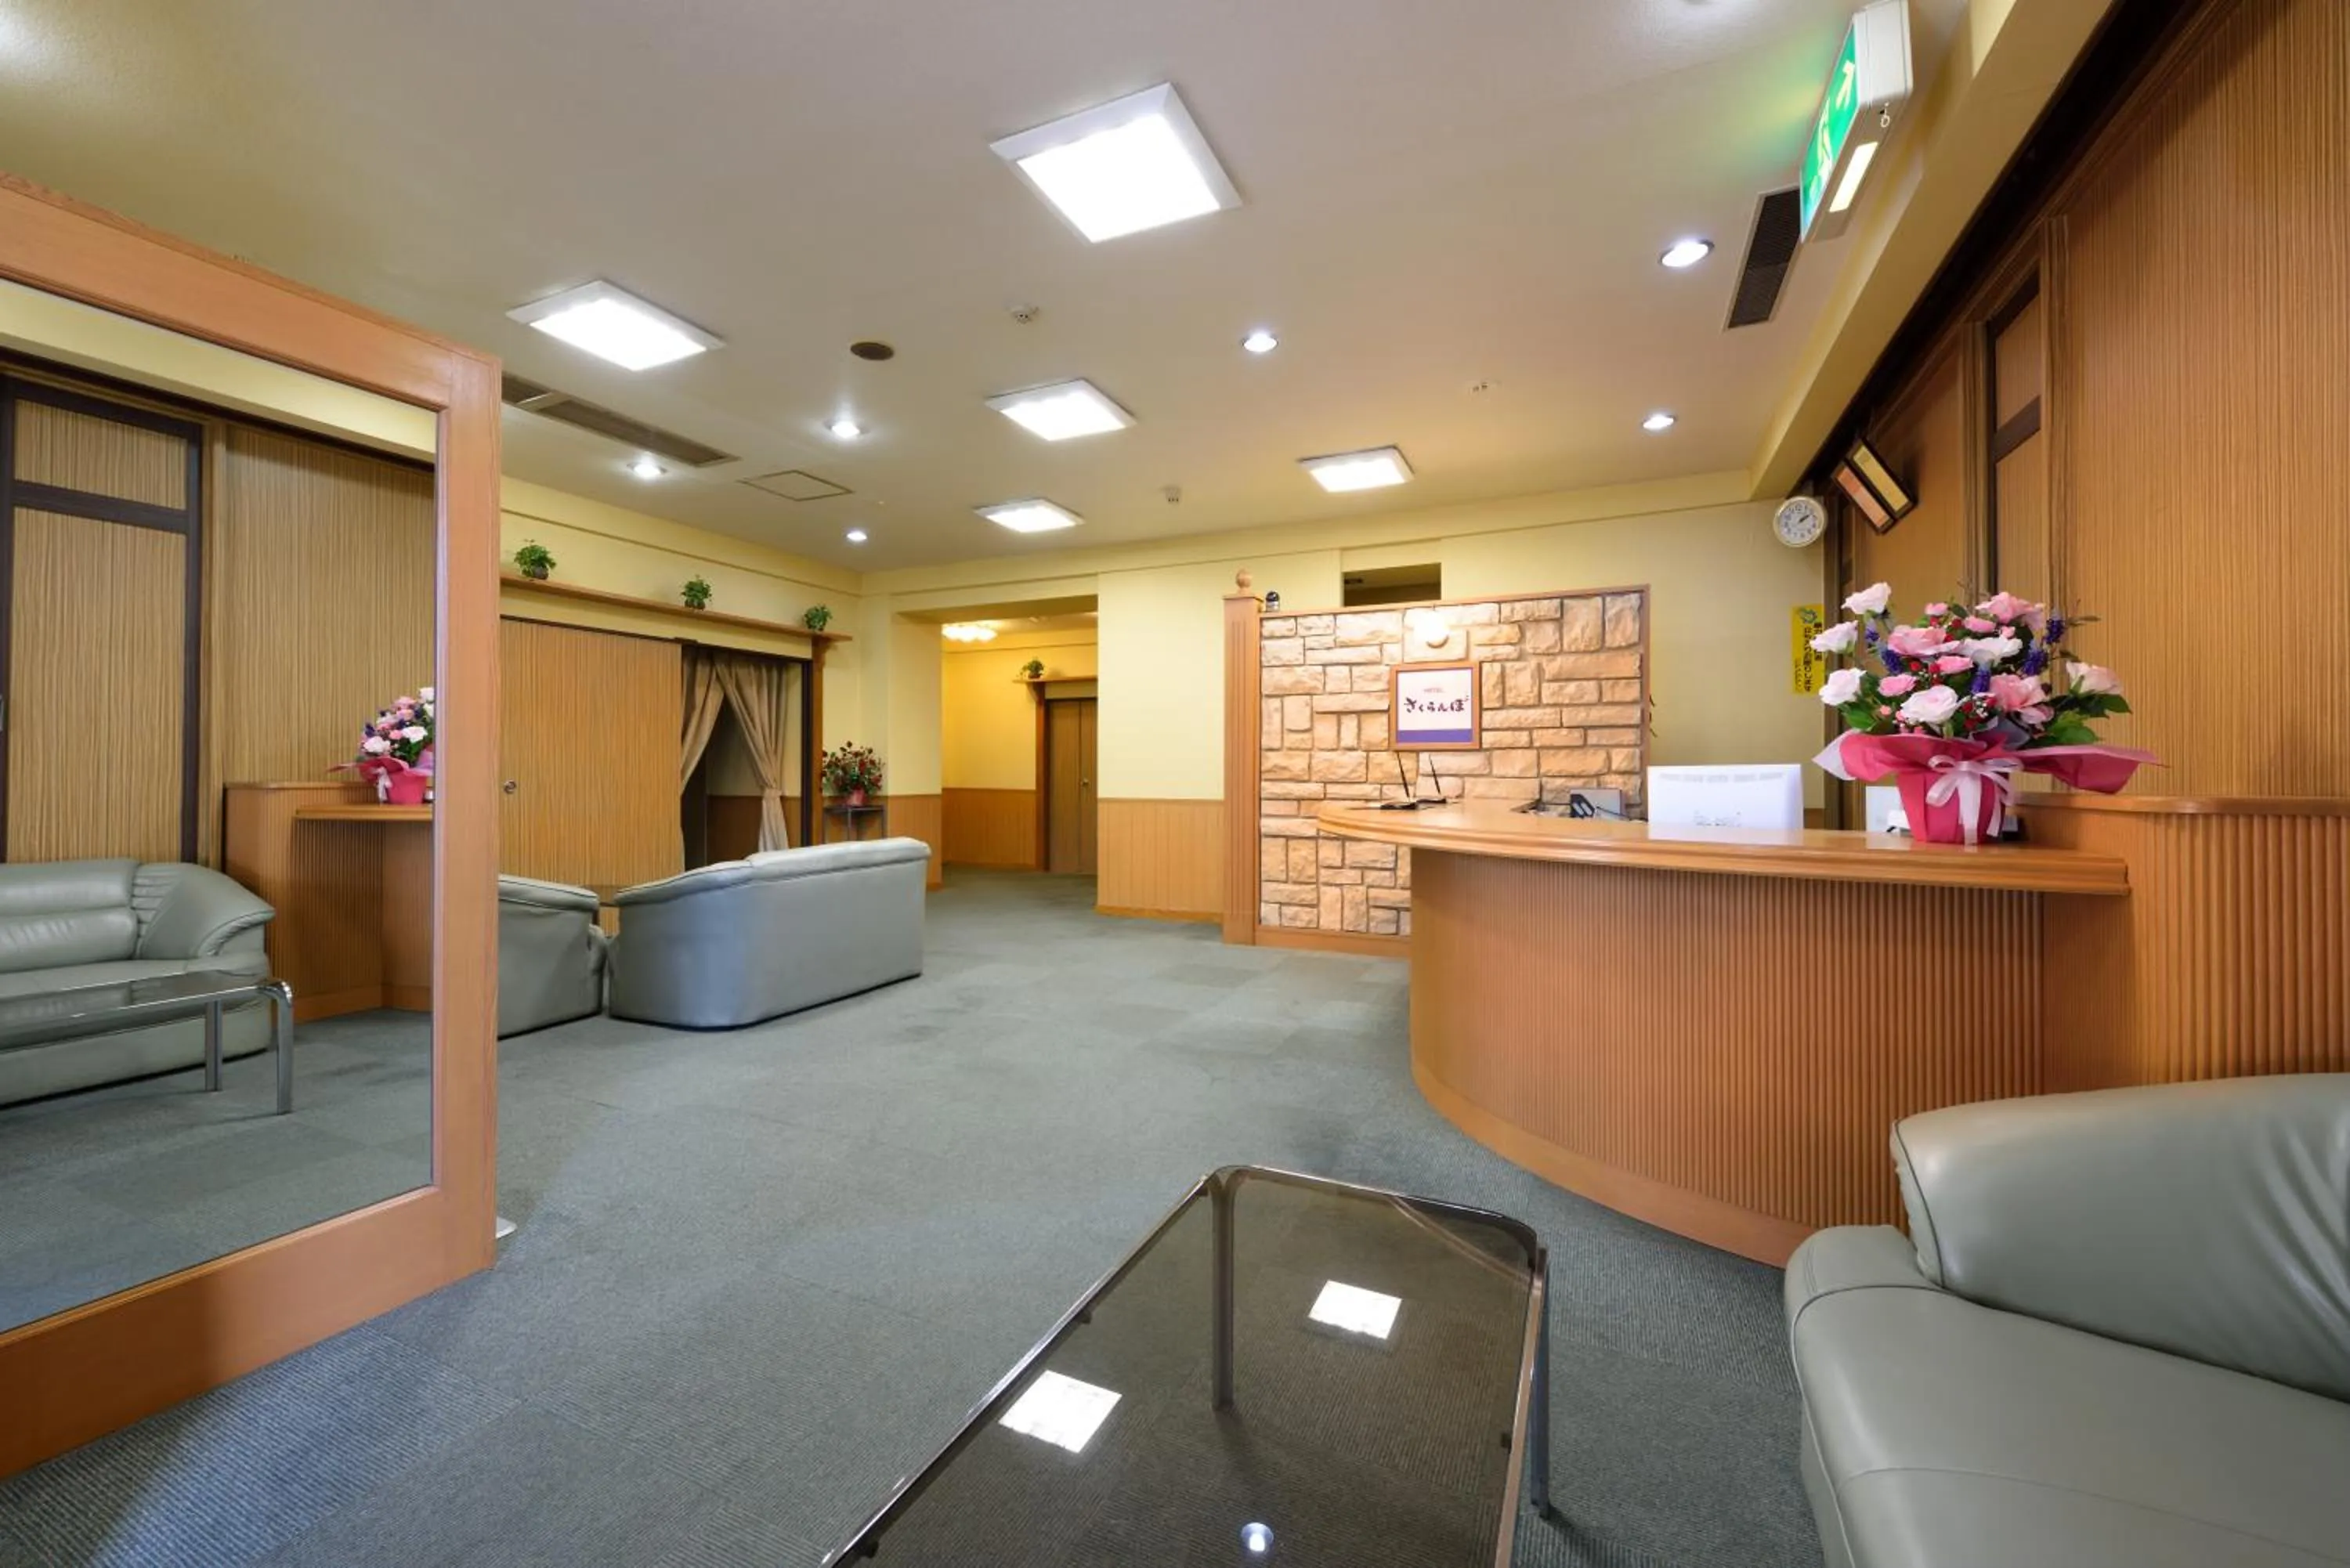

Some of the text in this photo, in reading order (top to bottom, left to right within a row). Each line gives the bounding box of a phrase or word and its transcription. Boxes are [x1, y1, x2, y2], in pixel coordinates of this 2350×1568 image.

[1403, 695, 1470, 714] さくらんぼ
